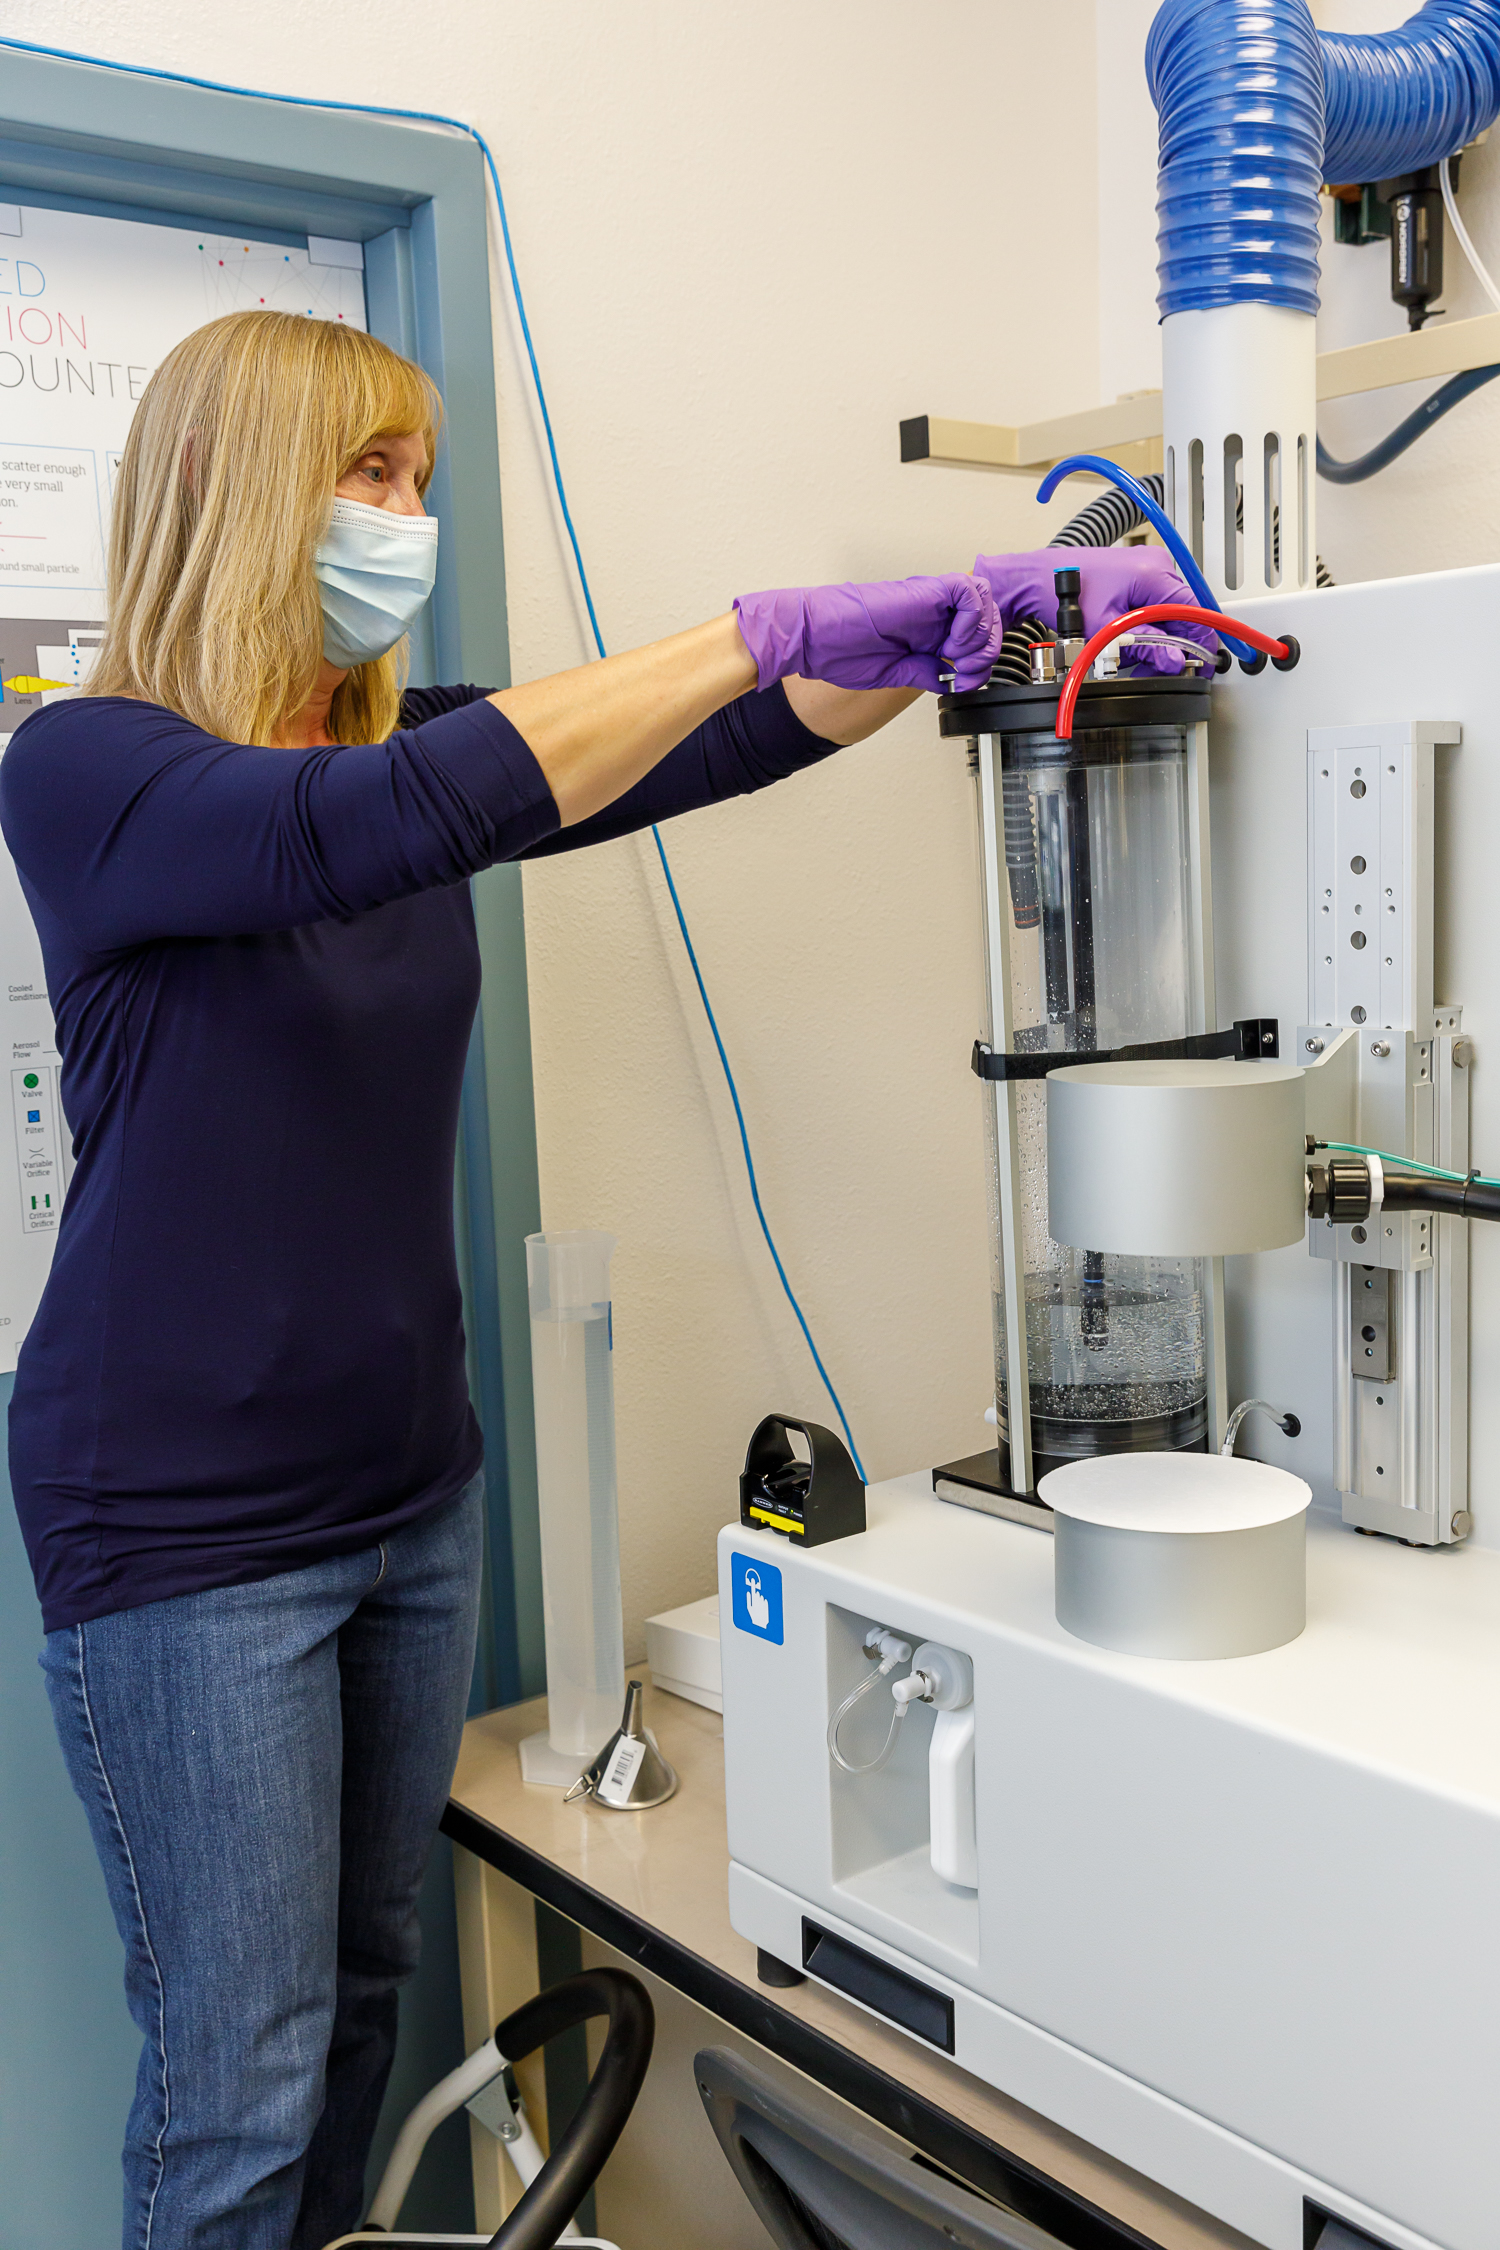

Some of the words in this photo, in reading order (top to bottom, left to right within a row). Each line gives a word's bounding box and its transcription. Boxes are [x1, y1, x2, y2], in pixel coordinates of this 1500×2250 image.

[2, 461, 41, 472] scatter
[44, 464, 86, 478] enough
[4, 479, 31, 492] very
[33, 481, 64, 492] small
[0, 498, 19, 508] on.
[21, 563, 45, 572] small
[47, 564, 80, 574] particle
[13, 1041, 40, 1049] Aerosol
[21, 1090, 43, 1098] Valve
[22, 1160, 53, 1169] Variable
[27, 1169, 51, 1178] Orifice
[29, 1211, 55, 1220] Critical
[30, 1220, 55, 1229] Orifice
